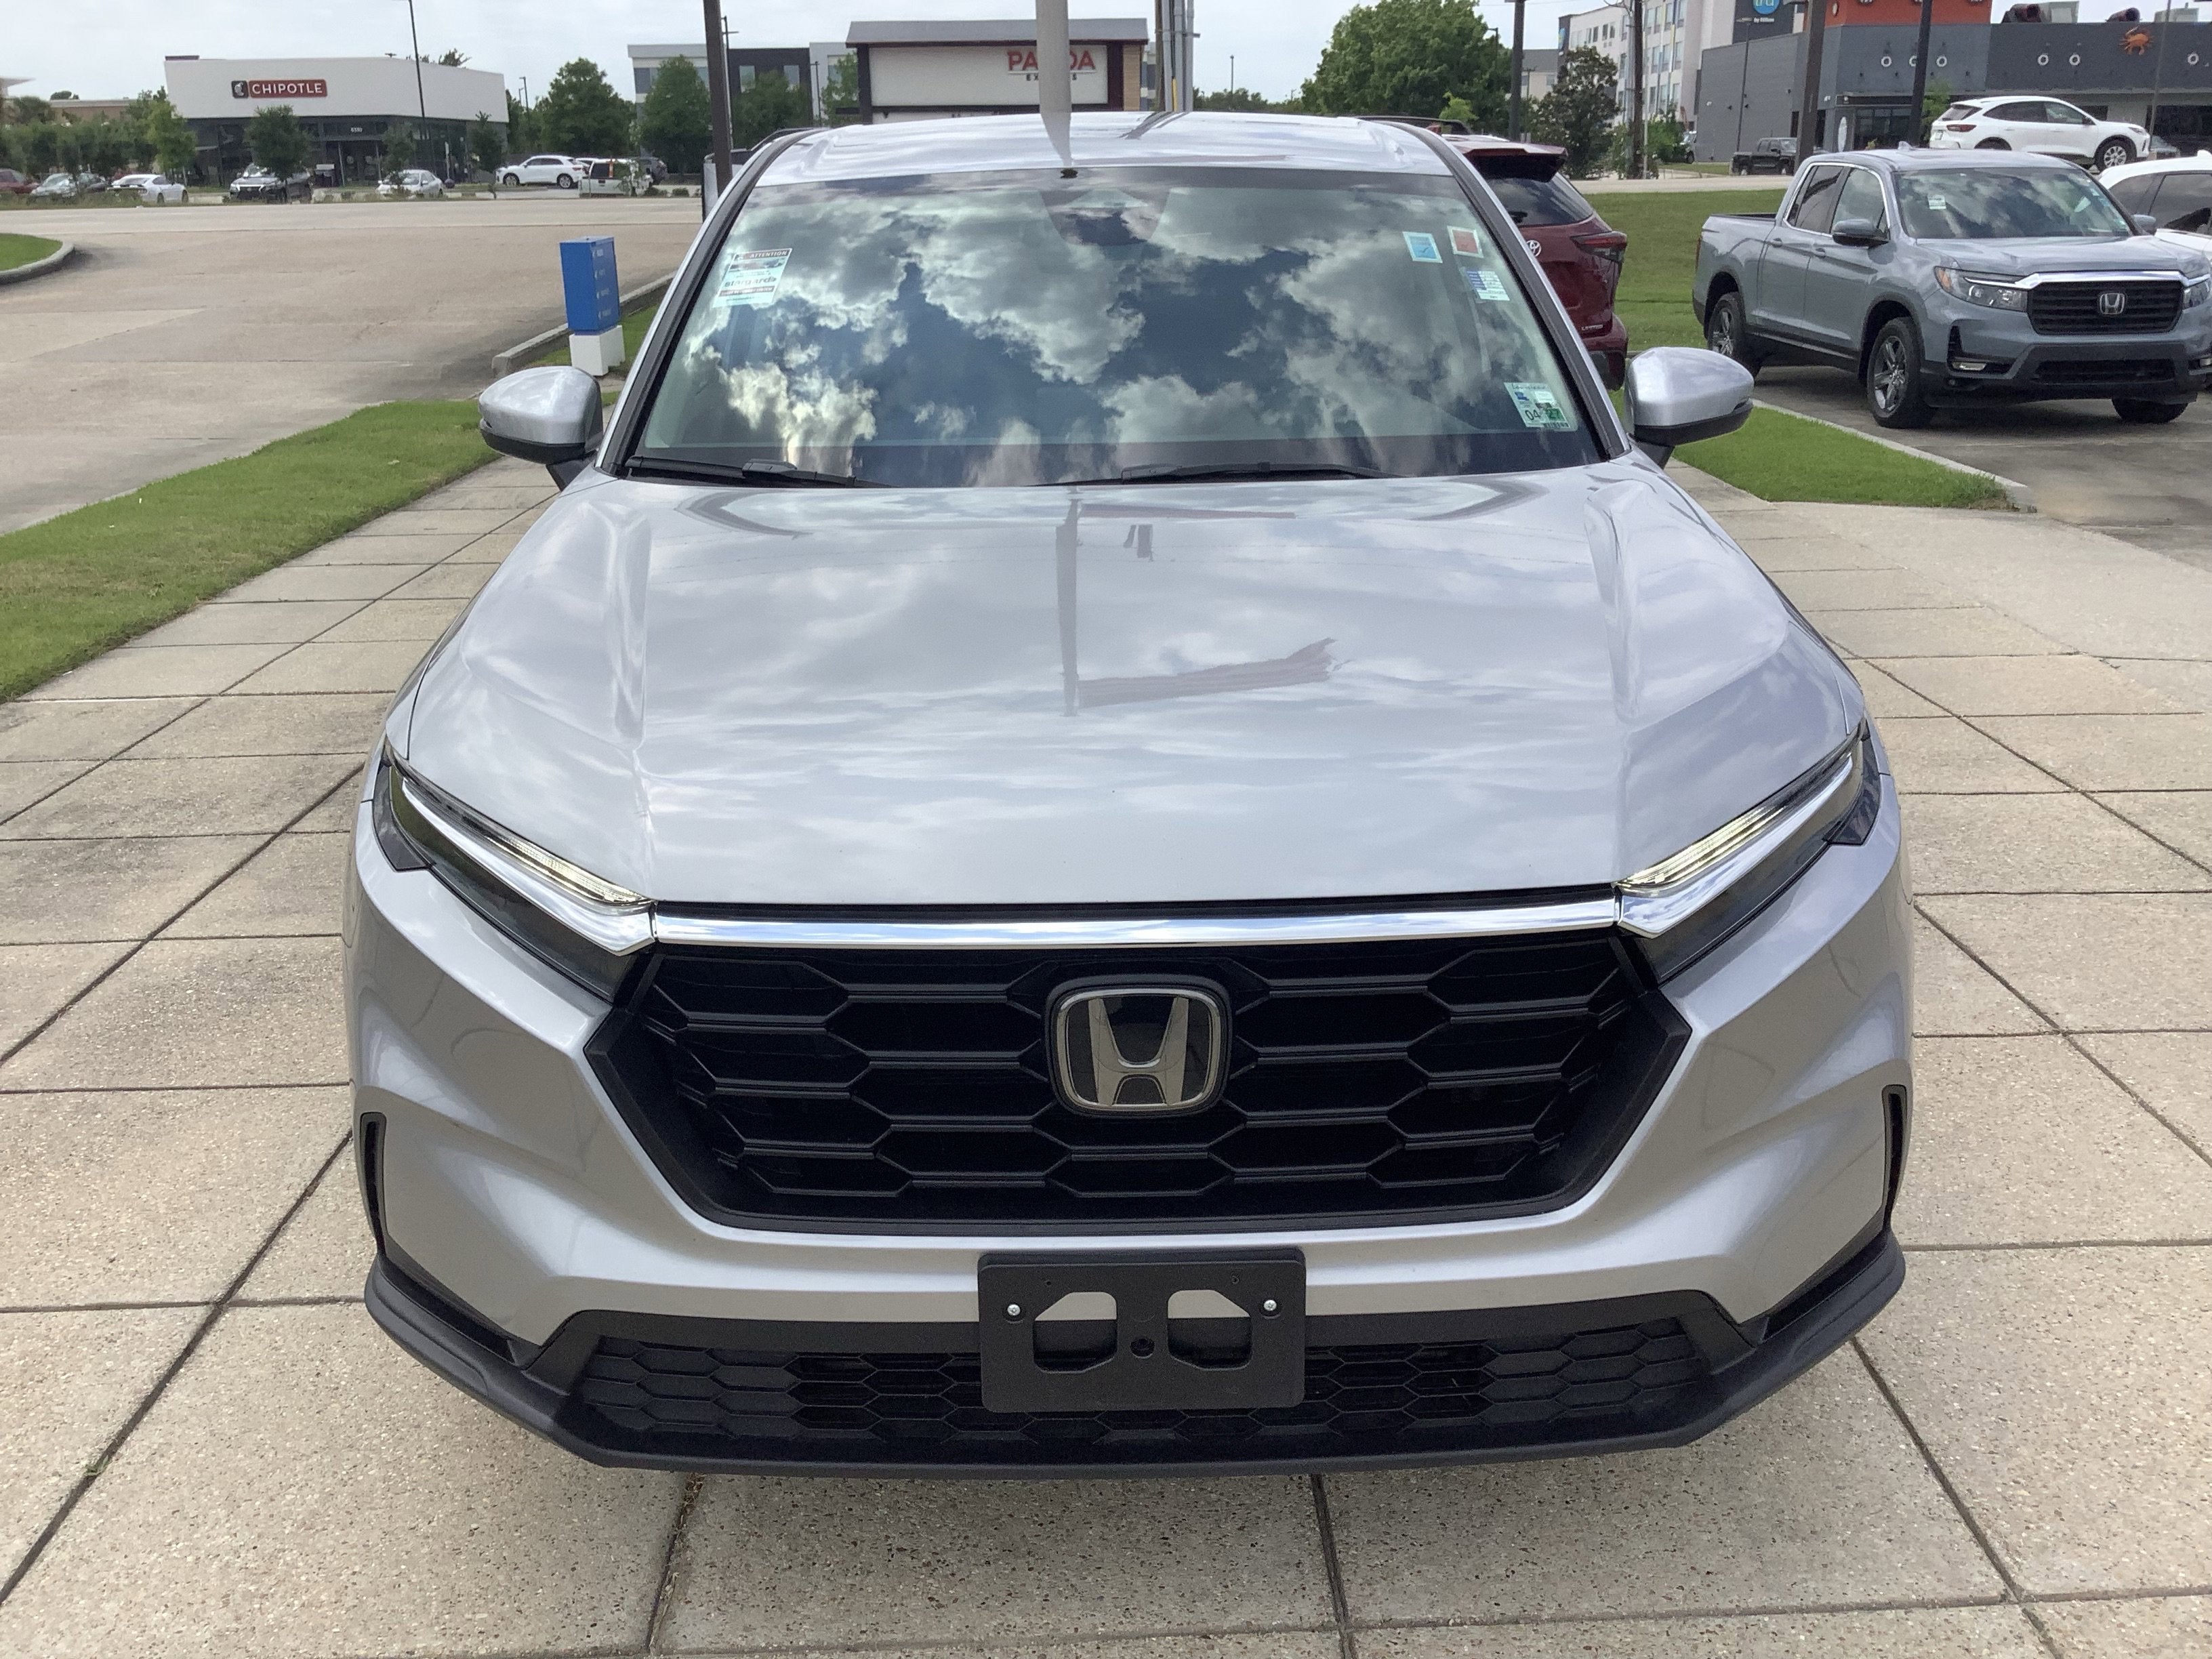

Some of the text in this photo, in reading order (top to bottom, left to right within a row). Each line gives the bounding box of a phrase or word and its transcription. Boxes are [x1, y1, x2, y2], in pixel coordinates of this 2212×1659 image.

[1007, 50, 1097, 70] PAA
[251, 83, 323, 94] CHIPOTLE
[750, 250, 787, 258] ATTENTION
[1525, 409, 1541, 420] 04
